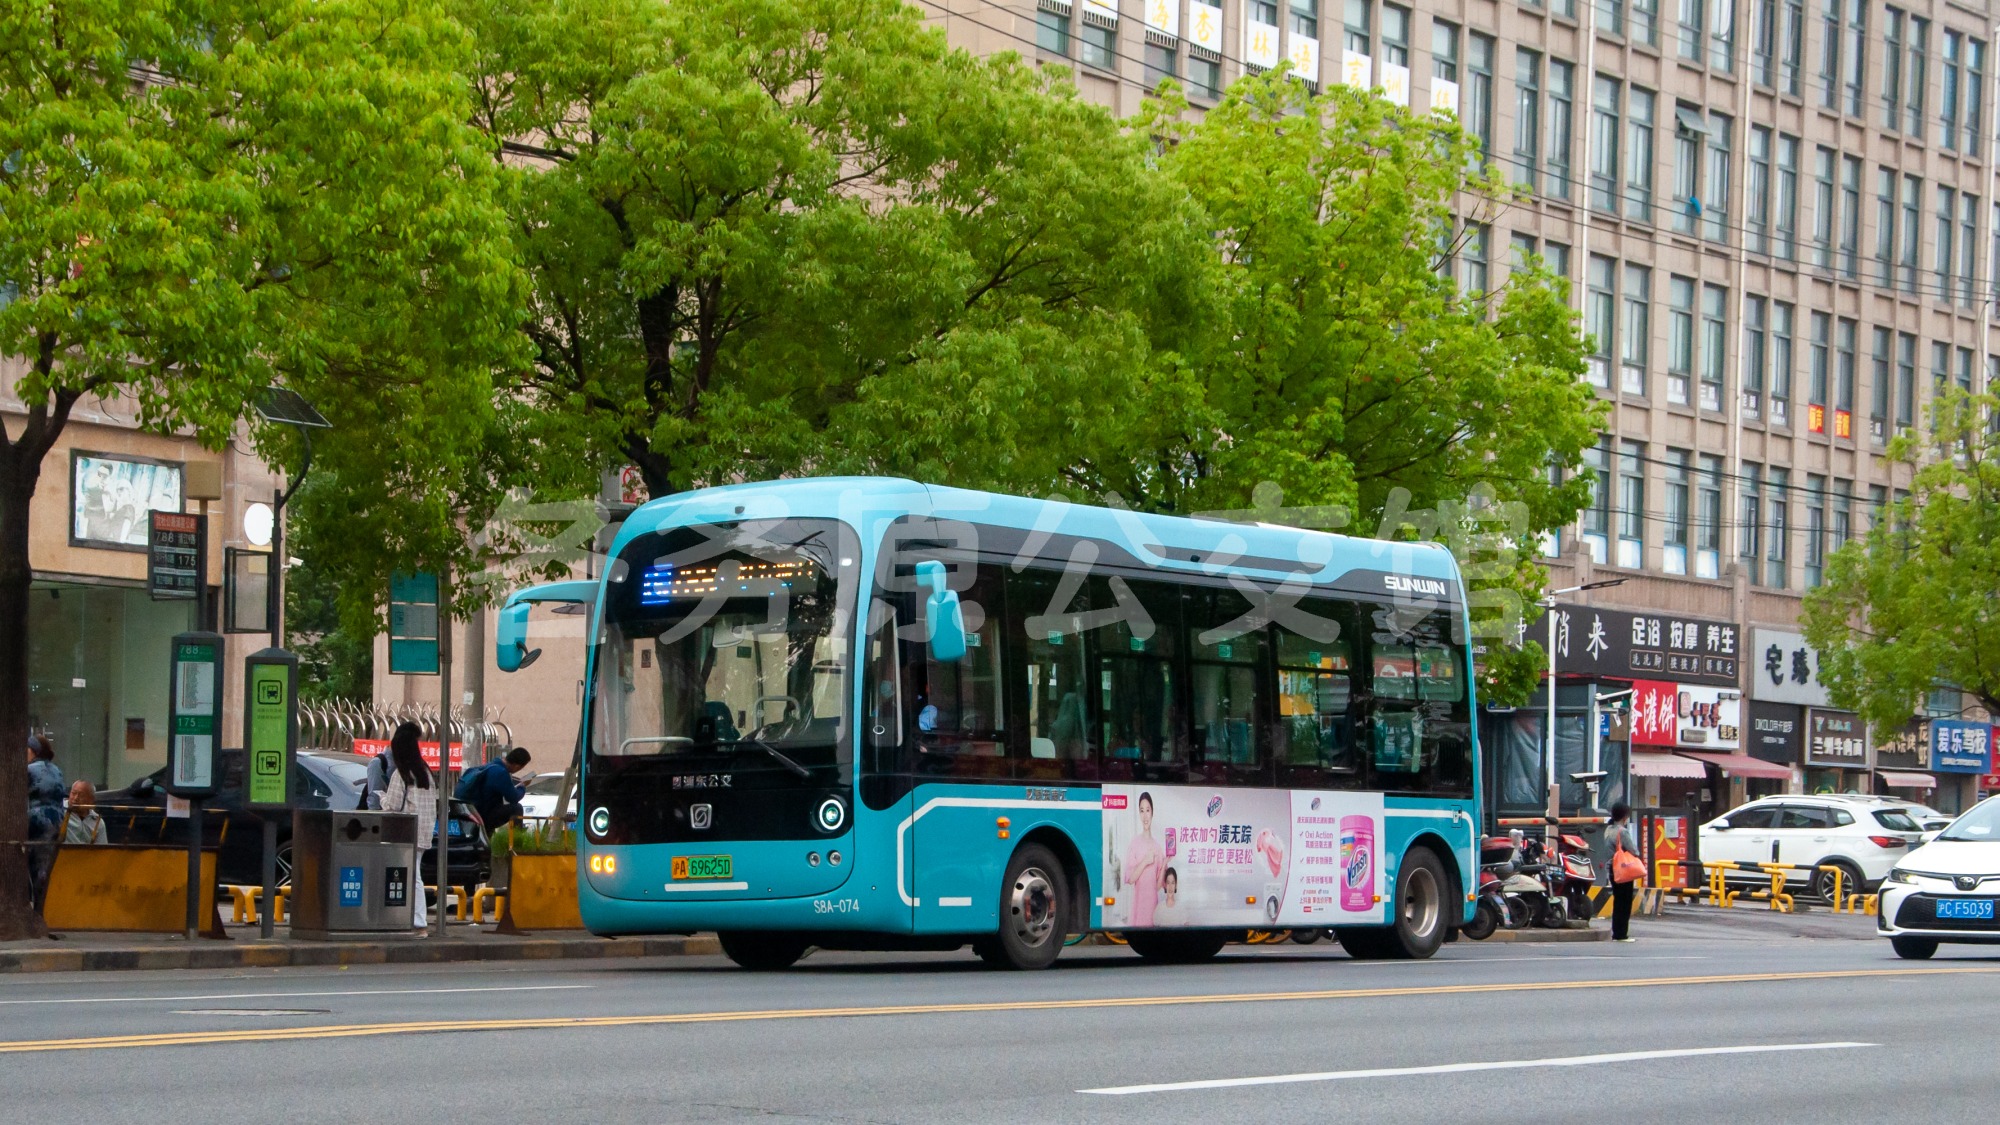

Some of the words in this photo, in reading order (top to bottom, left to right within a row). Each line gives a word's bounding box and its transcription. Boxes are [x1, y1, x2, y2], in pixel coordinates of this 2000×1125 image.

[156, 532, 174, 543] 788
[179, 555, 196, 567] 175
[1384, 575, 1446, 595] SUNWIN
[1632, 617, 1661, 647] 足浴
[1670, 620, 1698, 650] 按摩
[1706, 624, 1734, 654] 养生
[180, 645, 199, 655] 788
[178, 717, 196, 728] 175
[1812, 736, 1864, 757] 兰州牛肉面
[1180, 824, 1252, 845] 洗衣加勺渍无踪
[1305, 831, 1315, 839] Oxi
[1315, 830, 1334, 839] Action
[1188, 848, 1253, 866] 去渍护色更轻松
